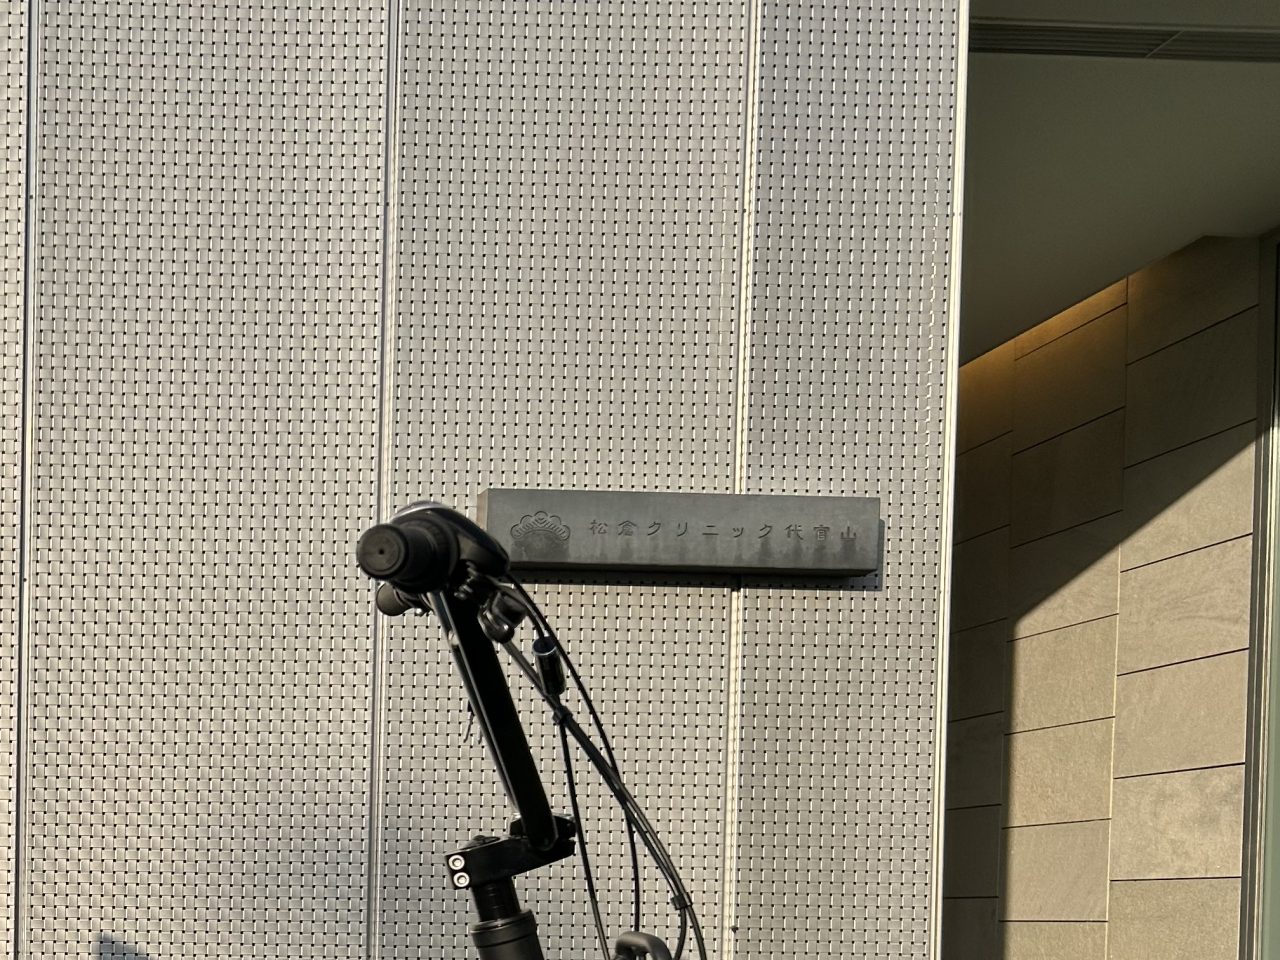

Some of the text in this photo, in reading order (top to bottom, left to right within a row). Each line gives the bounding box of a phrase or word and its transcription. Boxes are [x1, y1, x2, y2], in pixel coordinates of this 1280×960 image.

[589, 518, 857, 542] 松倉クリニック代官山
